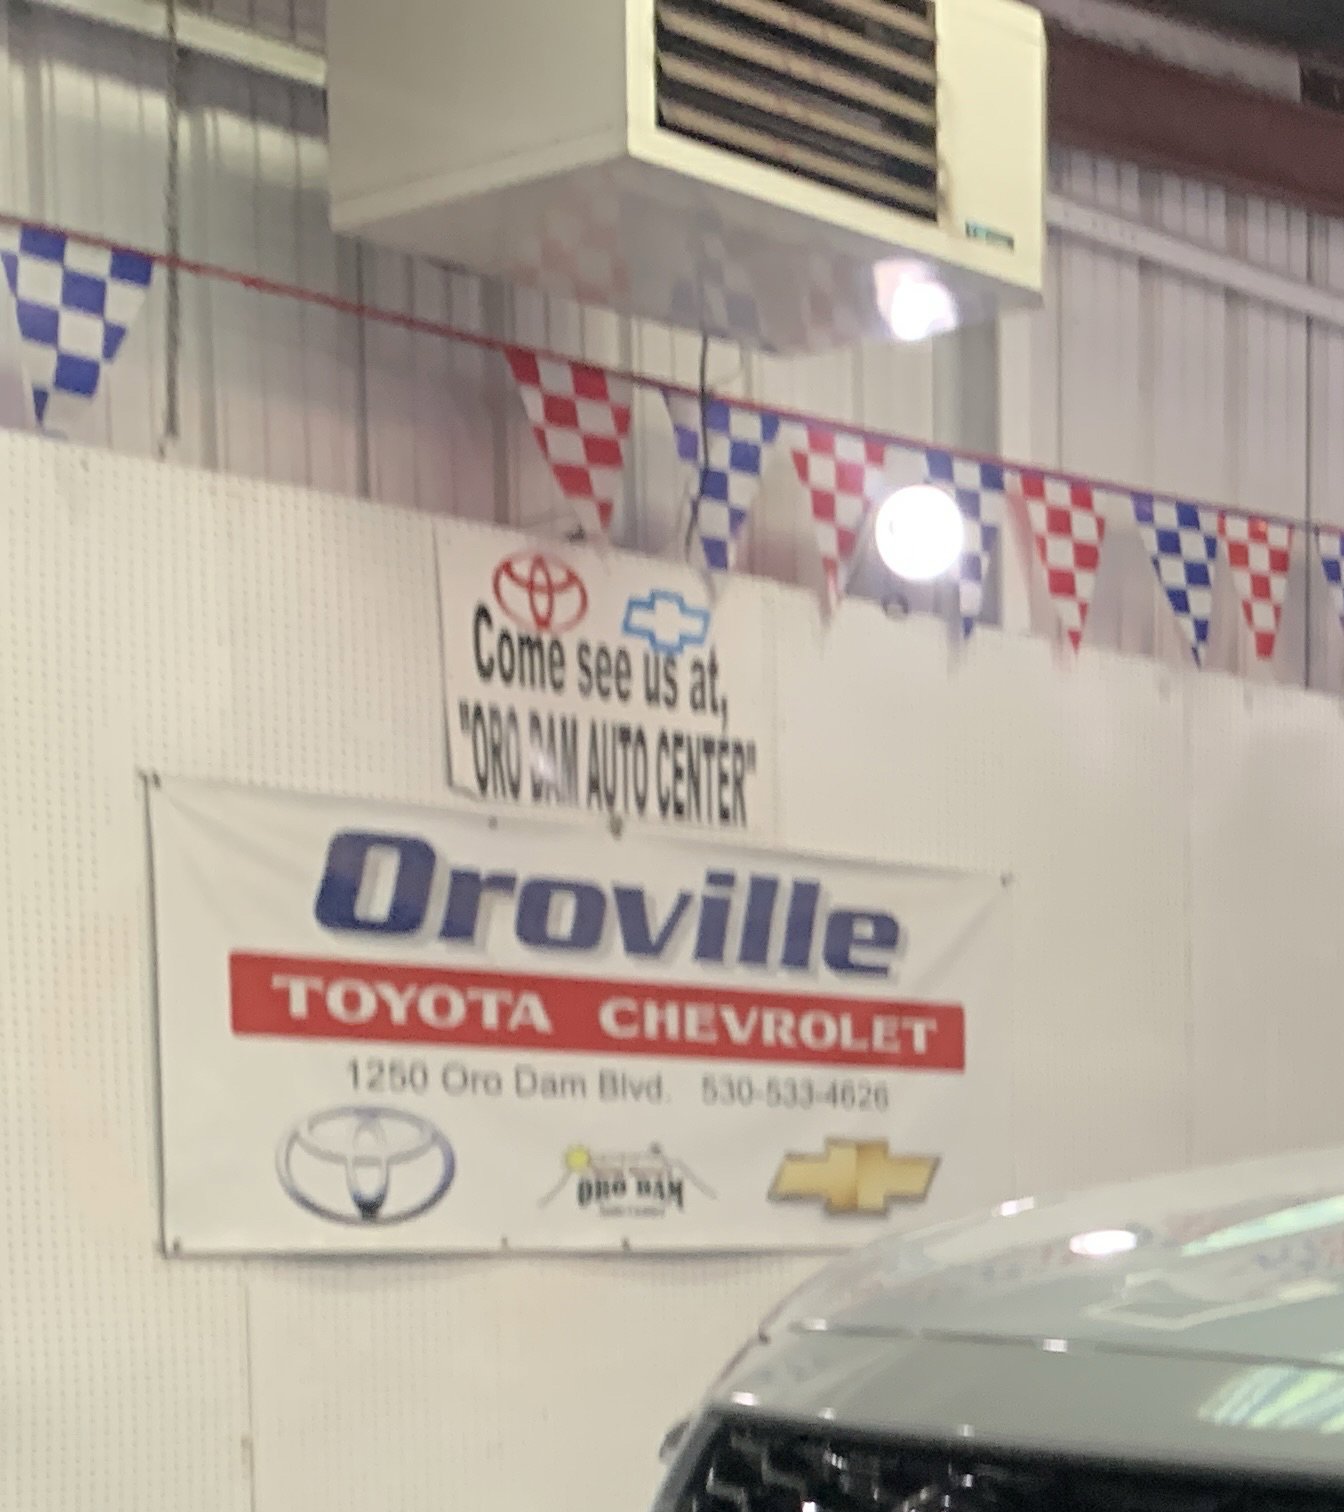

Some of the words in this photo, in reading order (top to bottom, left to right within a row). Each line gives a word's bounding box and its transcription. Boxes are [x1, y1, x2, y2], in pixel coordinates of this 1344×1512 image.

[473, 601, 566, 692] Come
[577, 639, 632, 703] see
[643, 651, 679, 710] us
[690, 646, 728, 733] at,
[587, 717, 649, 818] AUTO
[313, 829, 899, 977] Oroville
[271, 973, 553, 1034] TOYOTA
[598, 996, 937, 1055] CHEVROLET
[348, 1056, 428, 1096] 1250
[442, 1061, 503, 1098] Oro
[514, 1063, 587, 1100] Dam
